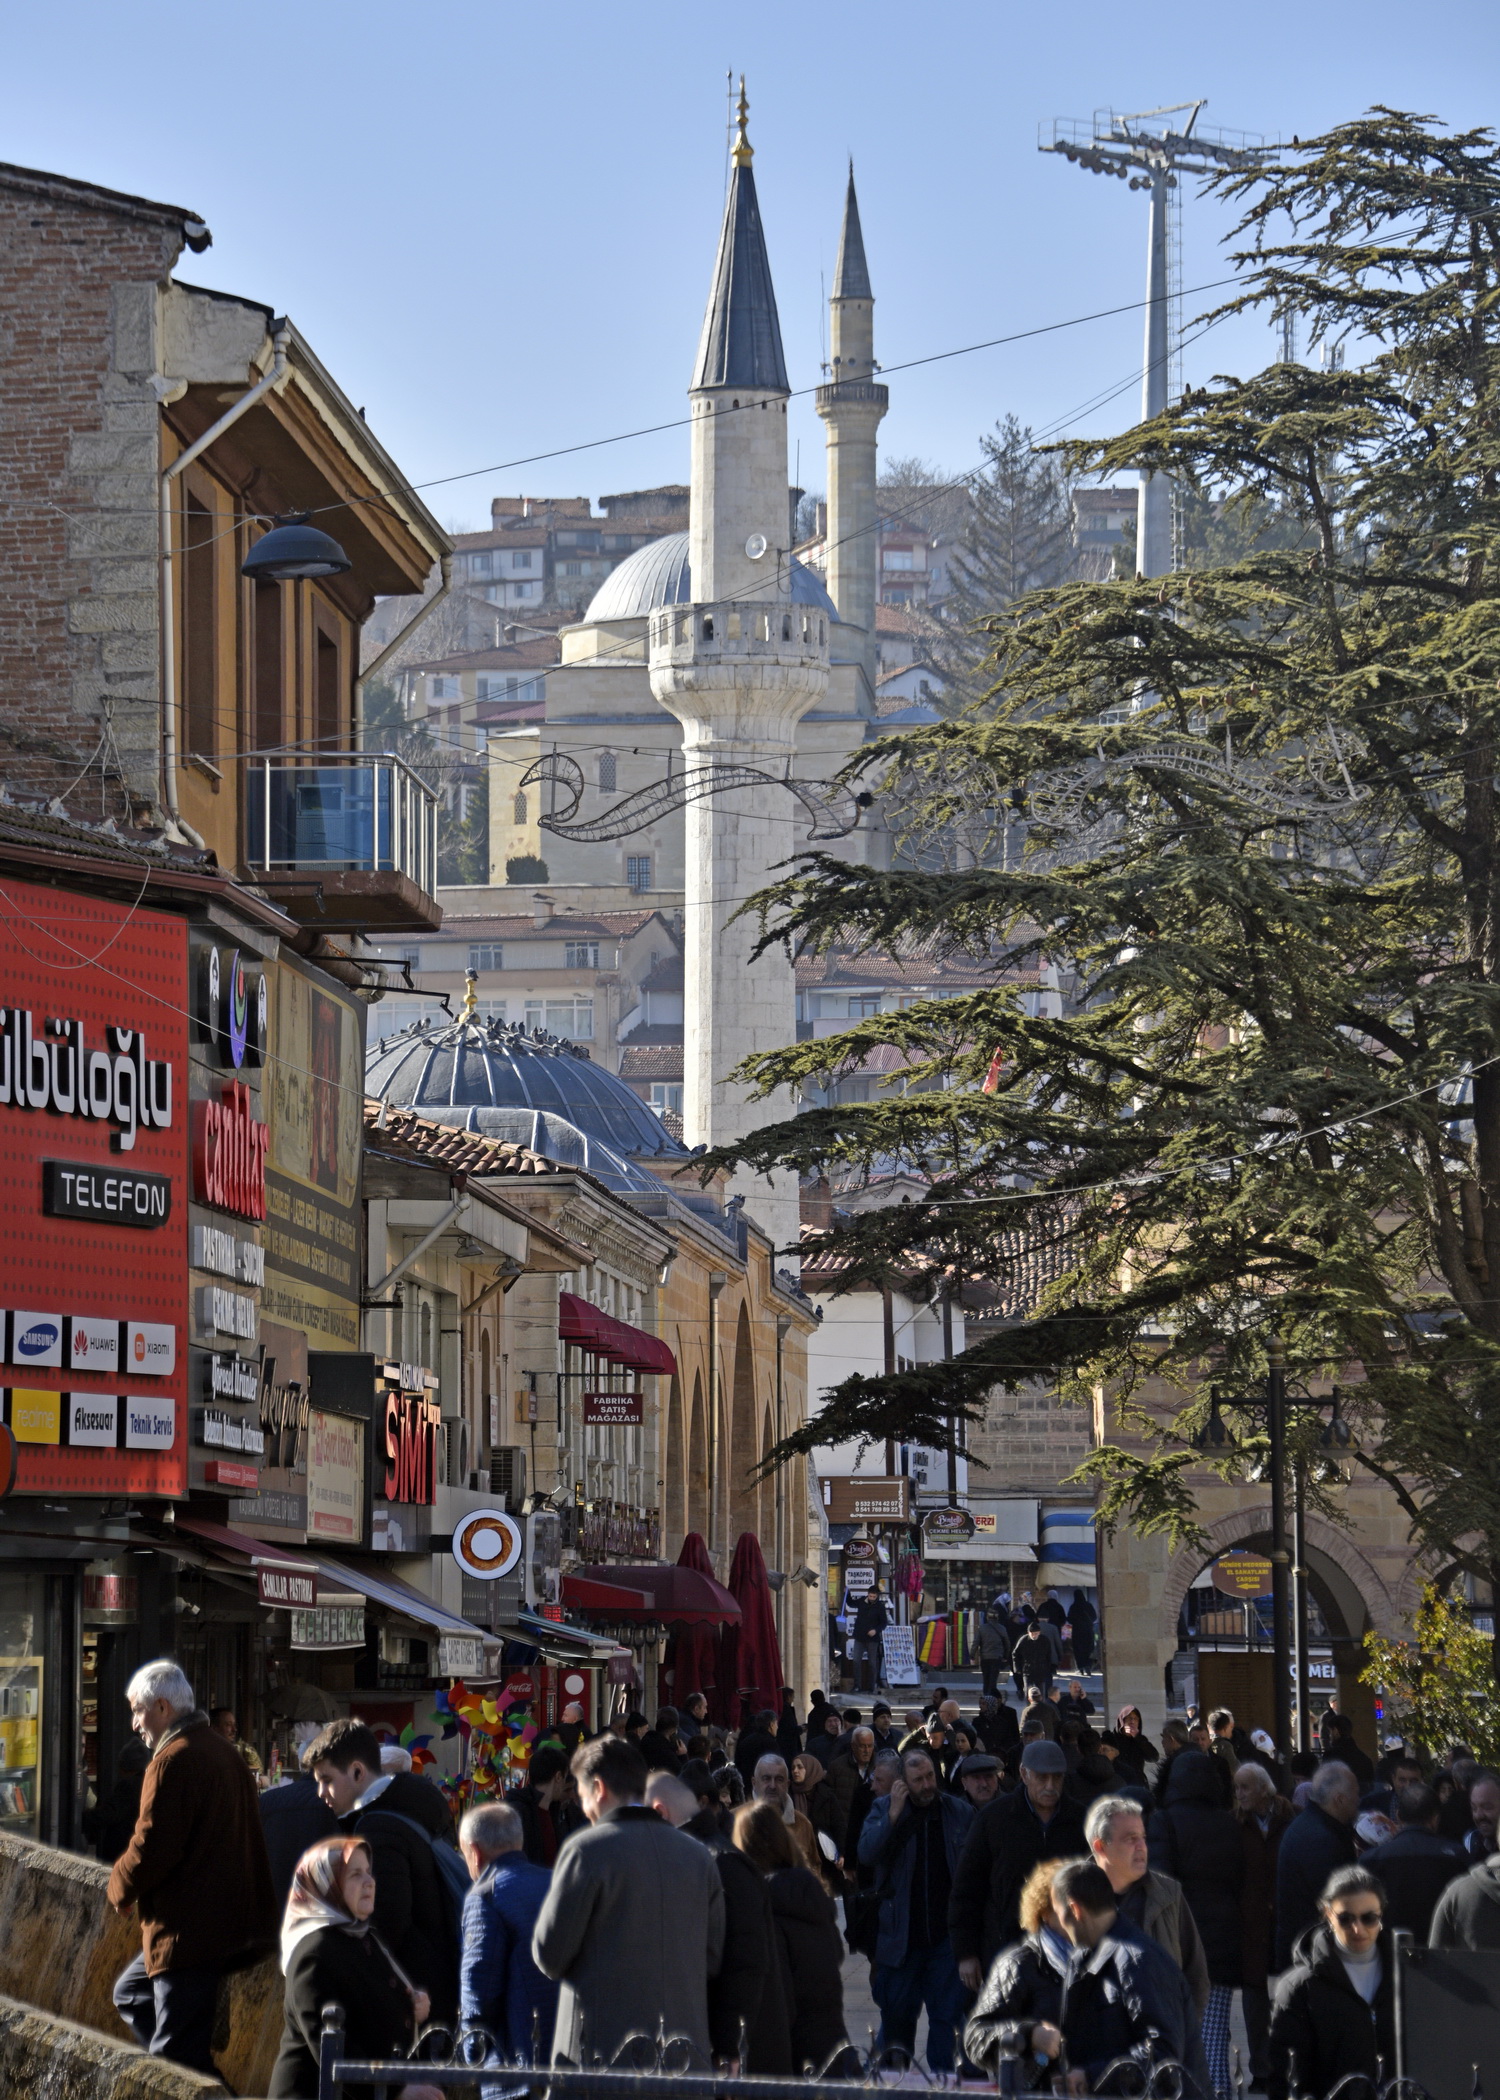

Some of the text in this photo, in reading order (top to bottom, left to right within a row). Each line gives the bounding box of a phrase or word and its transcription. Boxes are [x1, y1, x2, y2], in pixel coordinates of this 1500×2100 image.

[61, 1172, 165, 1217] TELEFON
[203, 1225, 236, 1278] PASTIRMA
[23, 1332, 54, 1348] SAMSUNG
[90, 1337, 117, 1352] HUAWEI
[594, 1396, 634, 1405] FABRİKA
[17, 1406, 55, 1429] realme
[587, 1413, 639, 1422] MAĞAZASI
[601, 1406, 627, 1415] SATIŞ
[75, 1407, 113, 1432] Aksesuar
[130, 1413, 172, 1436] Teknik Servis
[975, 1515, 994, 1526] ERZİ
[847, 1570, 873, 1578] TAŞKÖPRÜ
[262, 1572, 313, 1604] CANLILAR PASTIRMA
[506, 1683, 532, 1693] Coca-Cola
